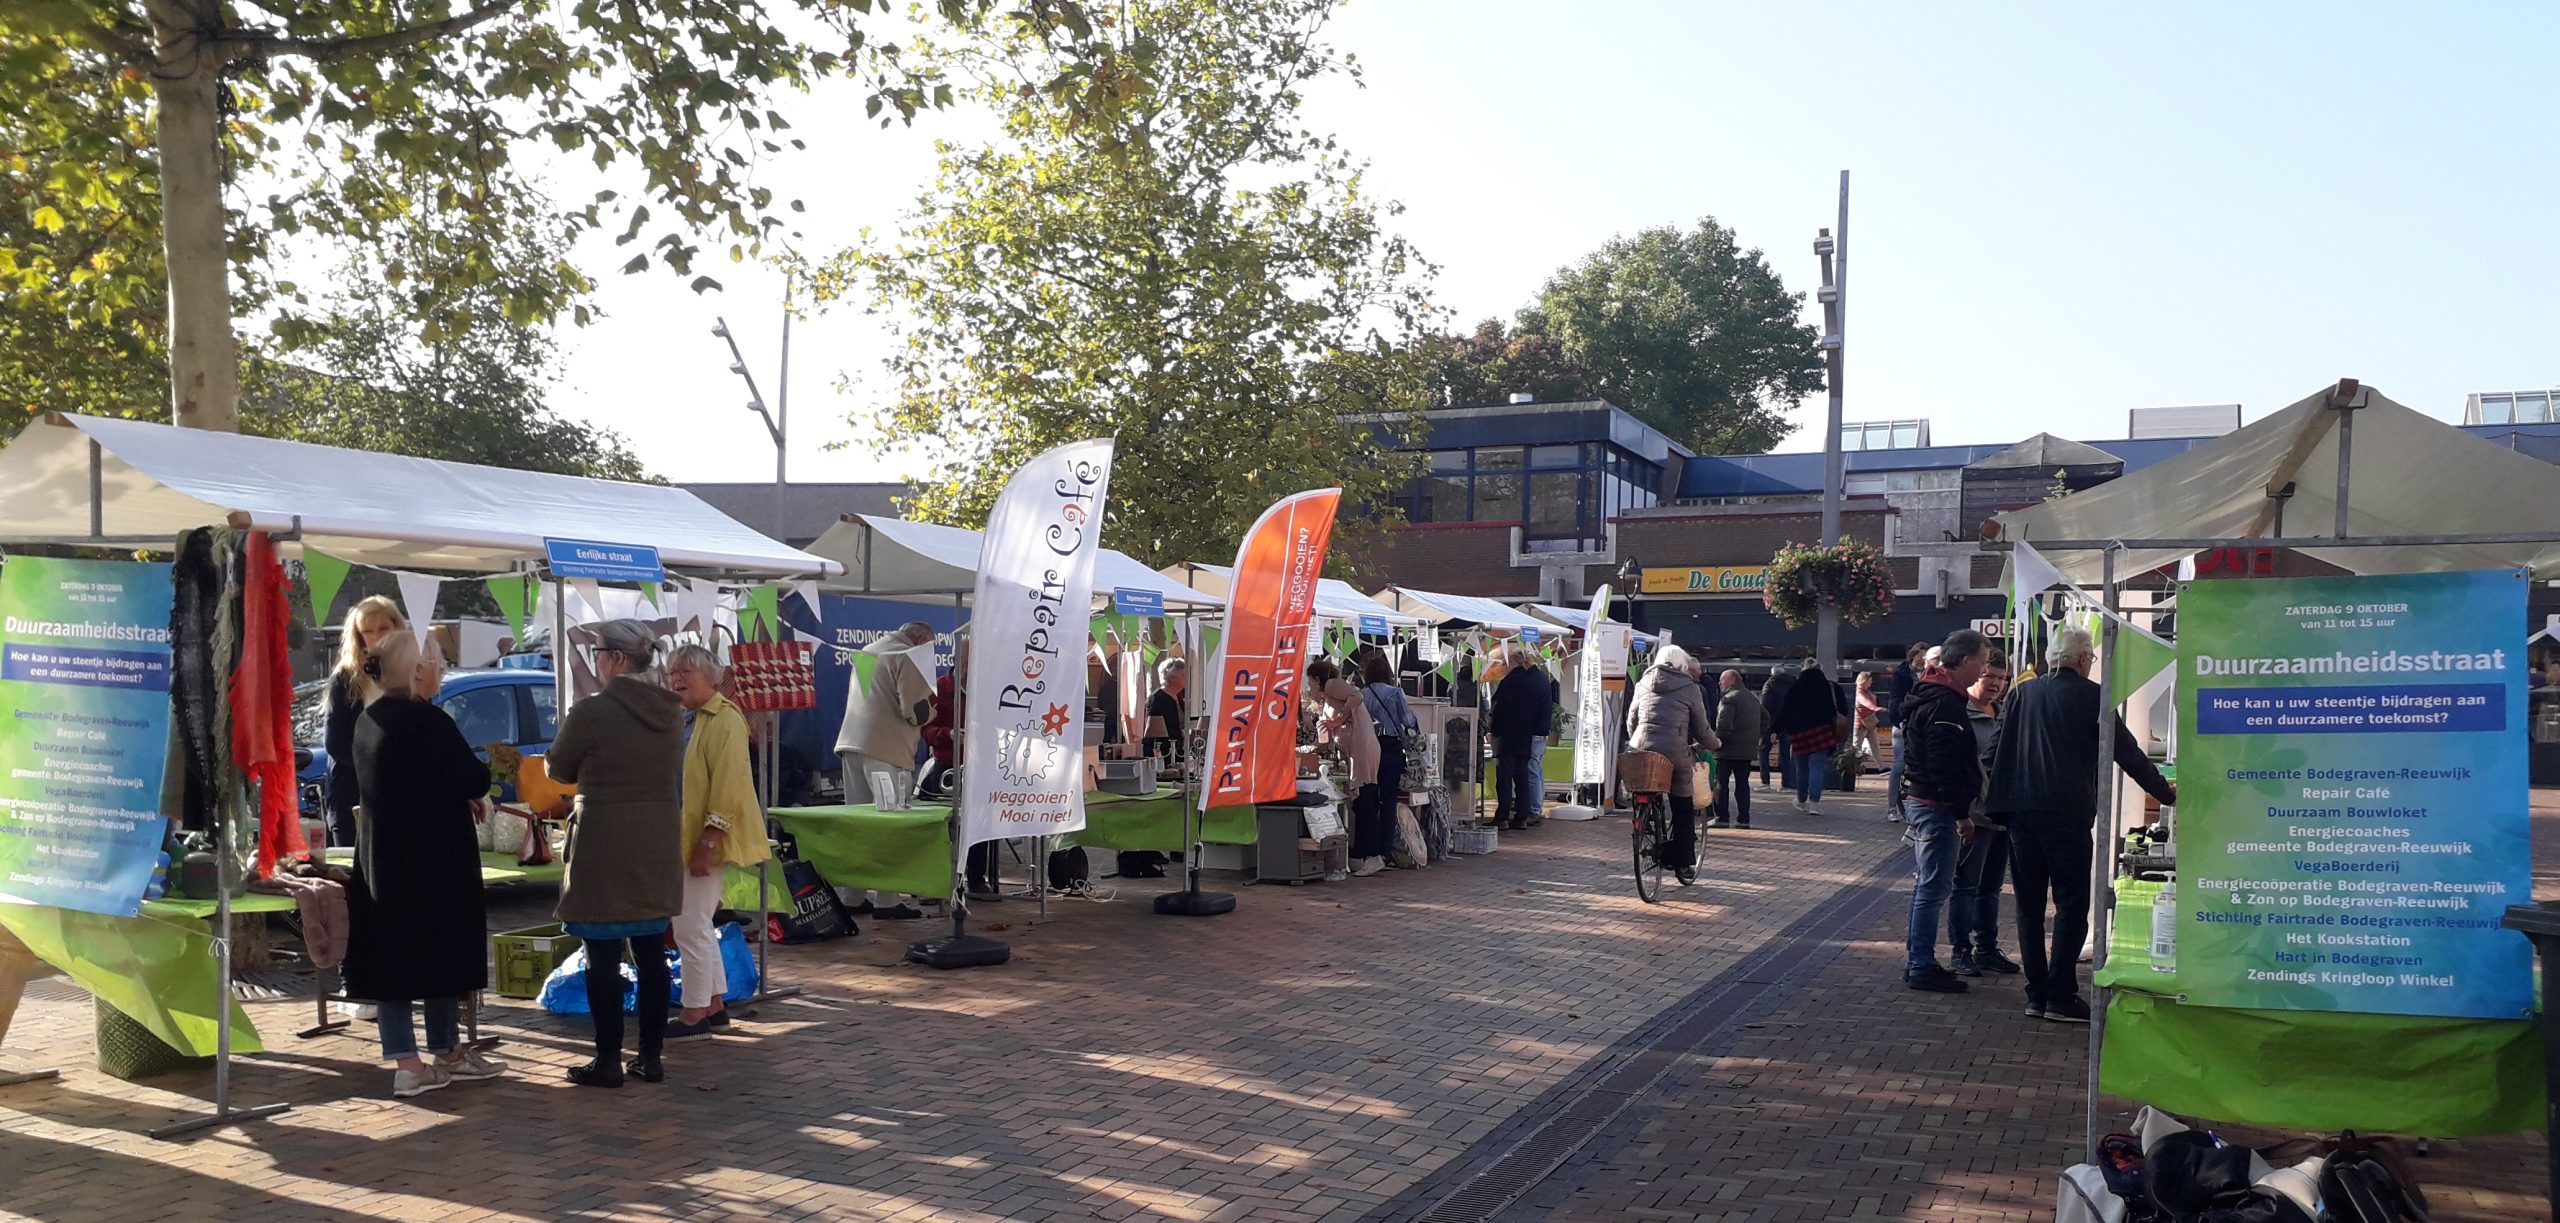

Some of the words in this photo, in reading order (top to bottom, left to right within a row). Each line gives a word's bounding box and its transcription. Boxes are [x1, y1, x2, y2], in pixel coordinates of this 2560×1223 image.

[576, 549, 607, 561] Eerlijke
[608, 552, 634, 562] straat
[1288, 527, 1309, 614] WEGGOOIEN?
[999, 569, 1066, 713] Repair
[1045, 460, 1102, 556] Café
[1688, 570, 1711, 589] De
[2285, 605, 2342, 616] ZATERDAG
[2346, 605, 2354, 614] 9
[2357, 603, 2409, 614] OKTOBER
[2301, 620, 2321, 629] van
[2324, 619, 2336, 628] 11
[2340, 619, 2356, 628] tot
[2360, 618, 2373, 627] 15
[2377, 619, 2395, 627] uur
[11, 651, 29, 661] Hoe
[32, 653, 48, 663] kan
[59, 656, 71, 664] uw
[72, 656, 104, 668] steentje
[106, 658, 145, 671] bijdragen
[147, 661, 163, 670] aan
[2196, 649, 2506, 676] Duurzaamheidsstraat
[30, 668, 48, 676] een
[50, 668, 97, 680] duurzamere
[98, 672, 143, 684] toekomst?
[2213, 698, 2240, 709] Hoe
[2245, 698, 2270, 709] kan
[2275, 699, 2284, 709] u
[2289, 699, 2310, 708] uw
[2314, 696, 2376, 710] steentje
[2381, 695, 2452, 709] bijdragen
[2457, 696, 2486, 706] aan
[15, 709, 59, 721] Gemeente
[2246, 715, 2272, 726] een
[2277, 714, 2364, 726] duurzamere
[2368, 712, 2449, 724] toekomst?
[57, 728, 85, 740] Repair
[1218, 669, 1260, 793] REPAIR
[44, 758, 114, 772] Energiecoaches
[12, 768, 51, 780] gemeente
[54, 771, 144, 788] Bodegraven-Reeuwijk
[2227, 768, 2302, 780] Gemeente
[2307, 767, 2471, 782] Bodegraven-Reeuwijk
[988, 790, 1074, 806] Weggooien?
[2302, 787, 2350, 801] Repair
[2355, 786, 2390, 799] Café
[69, 803, 156, 821] Bodegraven-Reeuwijk
[1000, 809, 1035, 823] Mooi
[1037, 809, 1072, 823] niet!
[2267, 806, 2341, 818] Duurzaam
[2347, 806, 2428, 818] Bouwloket
[35, 814, 45, 823] op
[46, 812, 136, 832] Bodegraven-Reeuwijk
[2289, 825, 2411, 840] Energiecoaches
[36, 844, 50, 854] Het
[2226, 841, 2301, 854] gemeente
[2307, 840, 2472, 856] Bodegraven-Reeuwijk
[2294, 860, 2400, 874] VegaBoerderij
[2197, 877, 2332, 891] Energiecoöperatie
[2338, 880, 2507, 896] Bodegraven-Reeuwijk
[2230, 893, 2242, 905] &
[2247, 893, 2274, 905] Zon
[2279, 897, 2298, 908] op
[2303, 894, 2469, 911] Bodegraven-Reeuwijk
[2196, 911, 2262, 926] Stichting
[2267, 912, 2335, 926] Fairtrade
[2286, 932, 2312, 944] Het
[2318, 933, 2411, 946] Kookstation
[2275, 951, 2306, 963] Hart
[2312, 951, 2326, 963] in
[2332, 952, 2423, 966] Bodegraven
[2247, 969, 2316, 985] Zendings
[2321, 971, 2395, 987] Kringloop
[2400, 973, 2454, 987] Winkel
